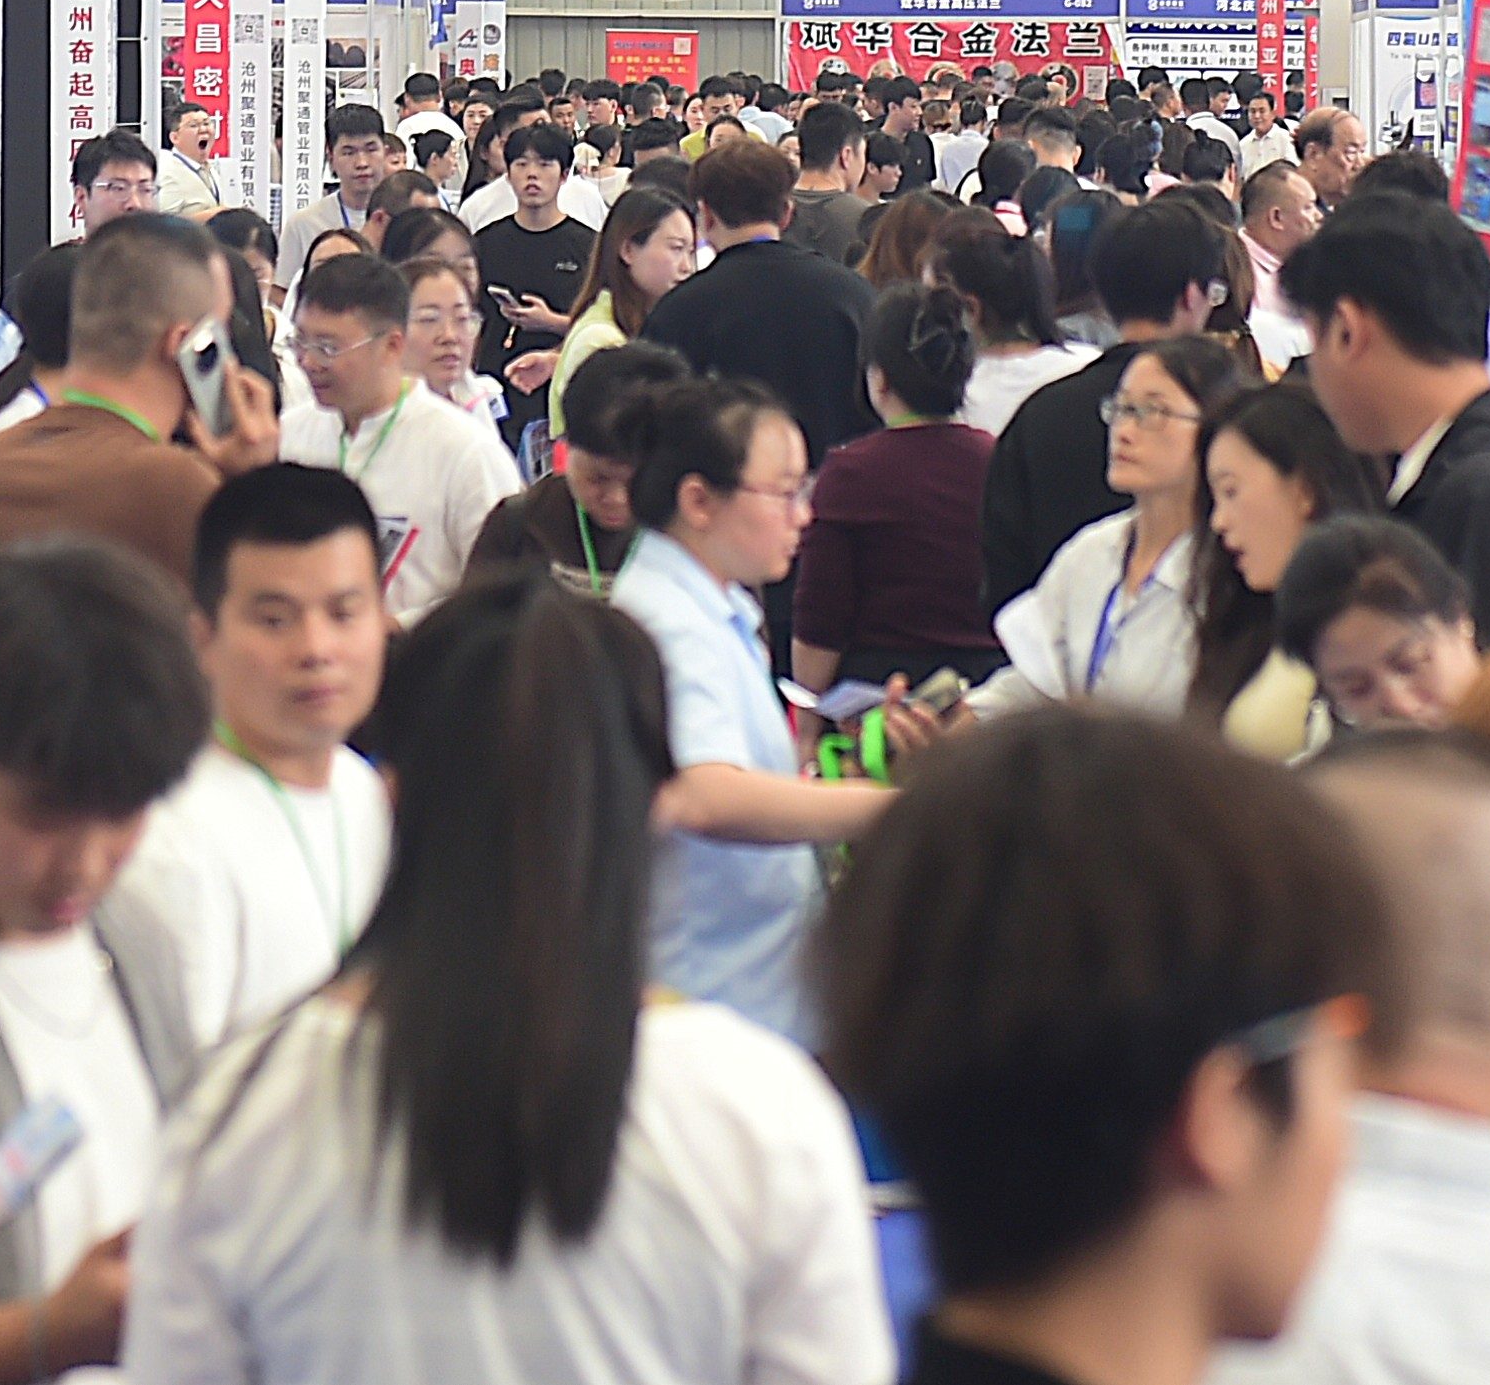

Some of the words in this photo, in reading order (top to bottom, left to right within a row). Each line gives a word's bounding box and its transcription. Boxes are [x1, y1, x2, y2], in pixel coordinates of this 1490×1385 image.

[802, 19, 1103, 57] 斌华合金法兰
